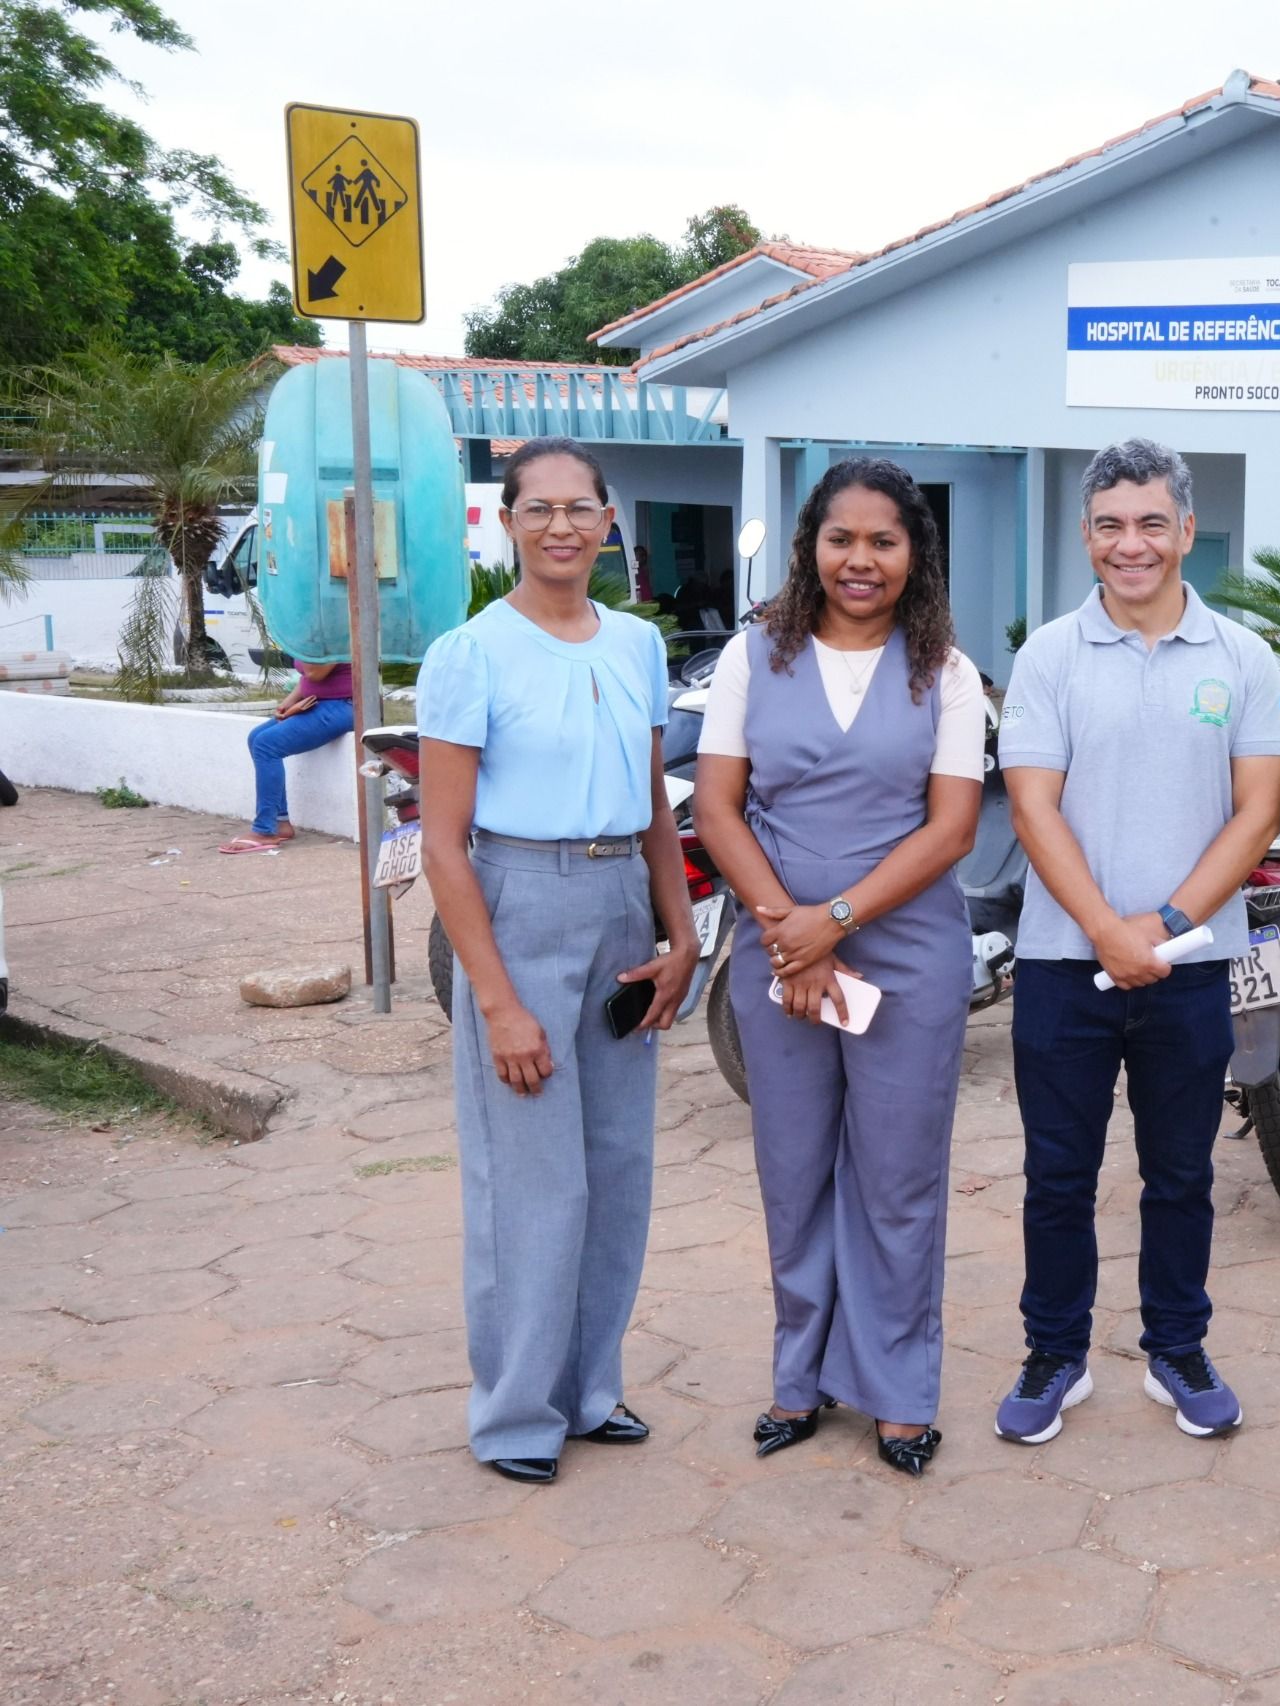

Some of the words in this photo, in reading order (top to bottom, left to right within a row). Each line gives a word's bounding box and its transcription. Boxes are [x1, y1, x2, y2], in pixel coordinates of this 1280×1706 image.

[1087, 321, 1165, 342] HOSPITAL
[1168, 320, 1190, 342] DE
[1195, 385, 1244, 400] PRONTO
[389, 833, 417, 858] RSF
[1230, 946, 1264, 978] MR
